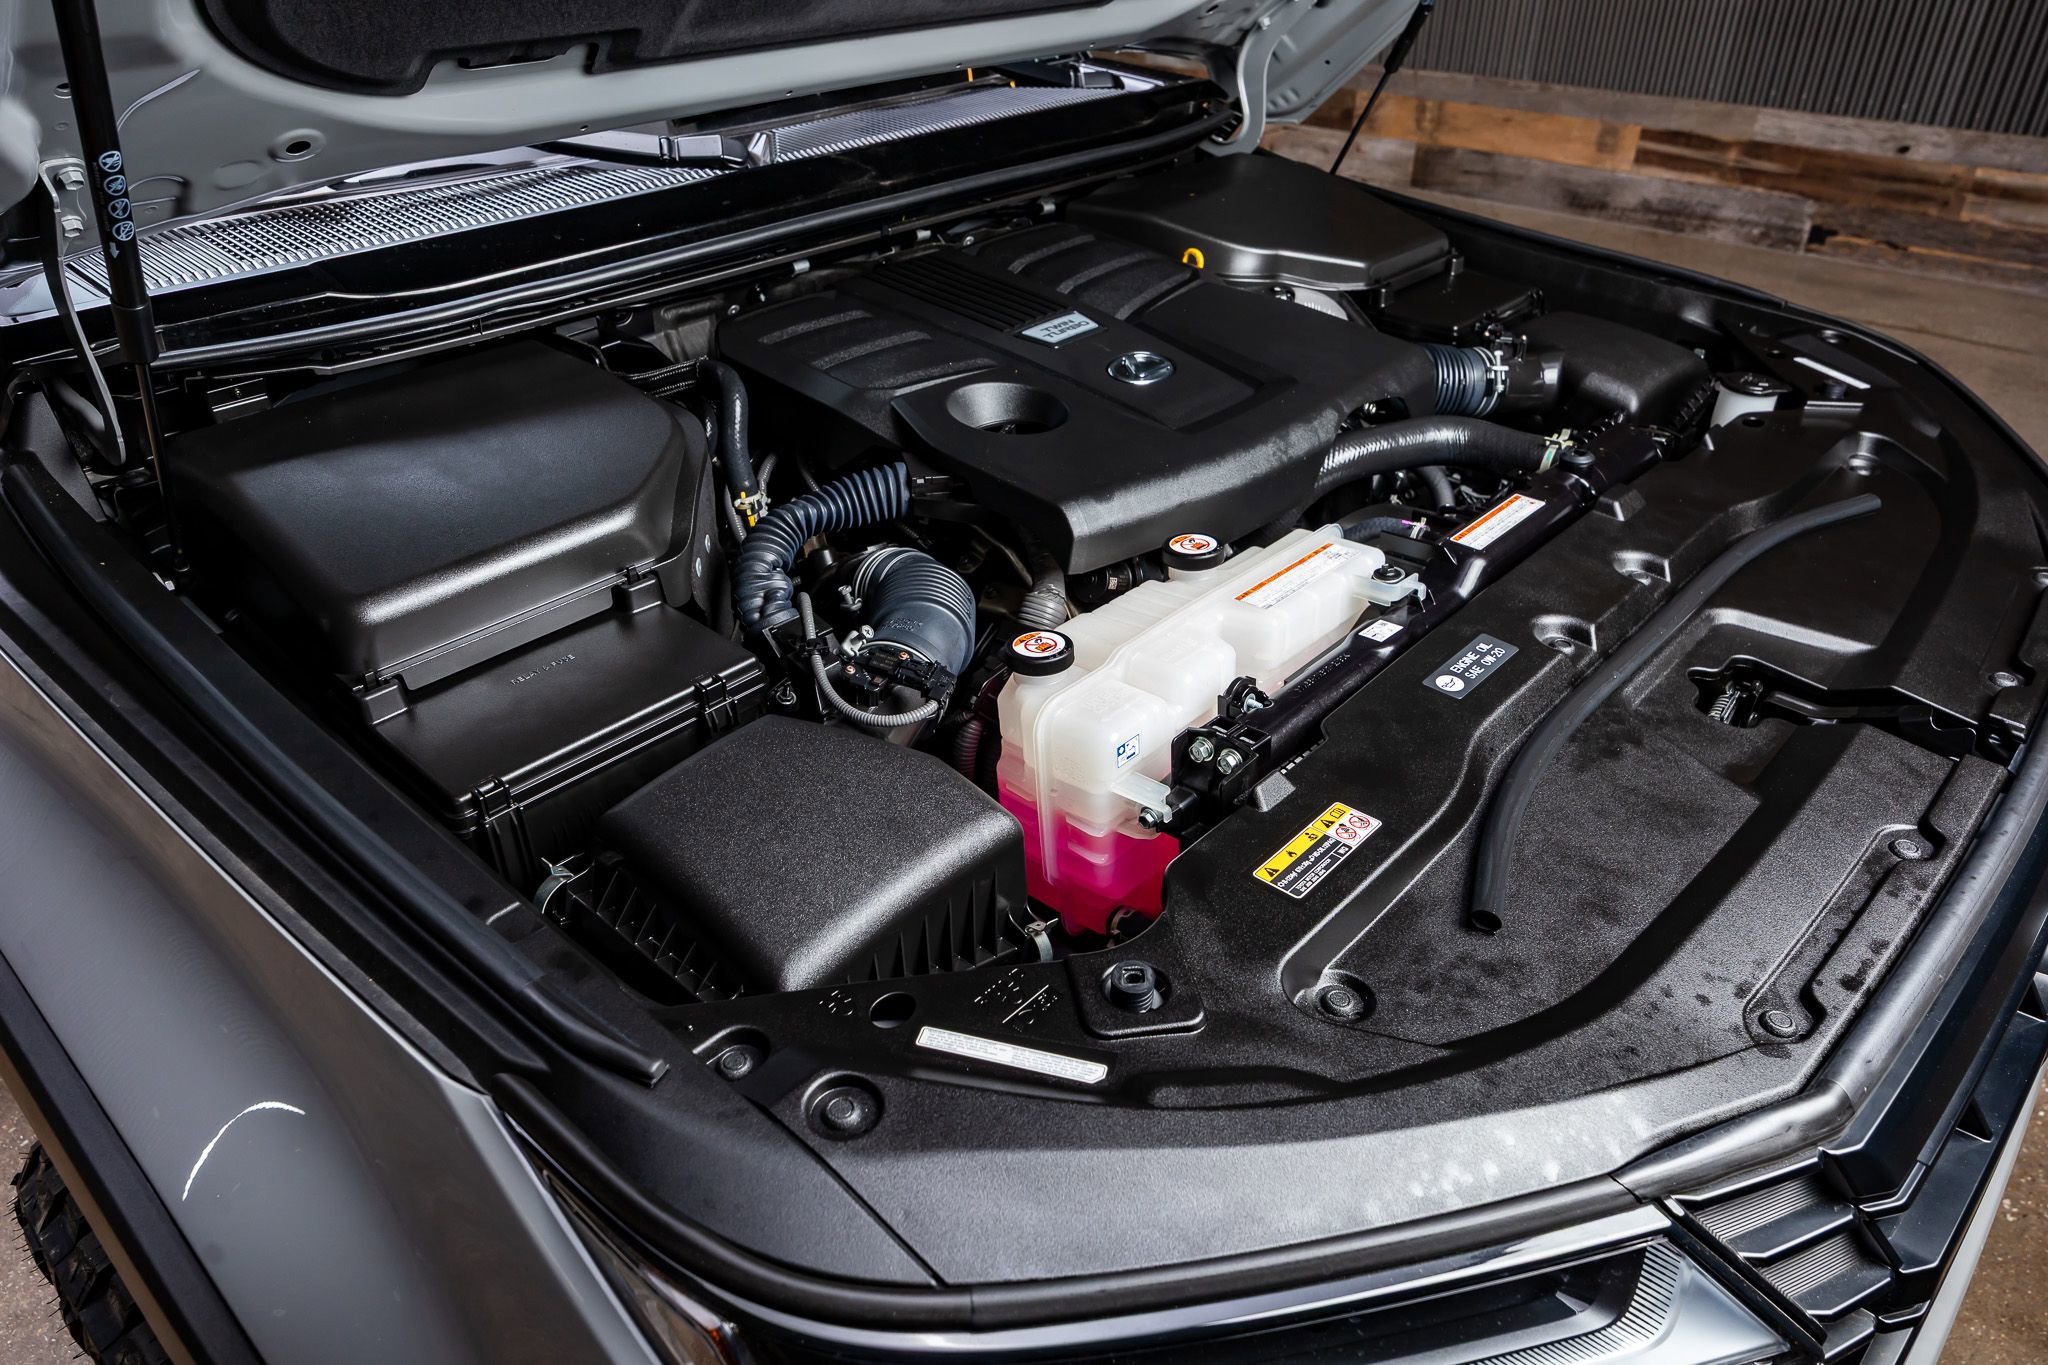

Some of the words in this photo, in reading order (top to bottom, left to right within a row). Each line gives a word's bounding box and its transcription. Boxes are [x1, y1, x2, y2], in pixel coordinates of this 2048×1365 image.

[1040, 319, 1075, 332] TWIN
[1042, 320, 1090, 338] TURBO
[1449, 651, 1480, 674] ENGINE
[1475, 642, 1493, 653] OIL
[1464, 664, 1485, 679] SAE
[1480, 647, 1506, 666] 0W-20
[510, 668, 541, 685] RELAY
